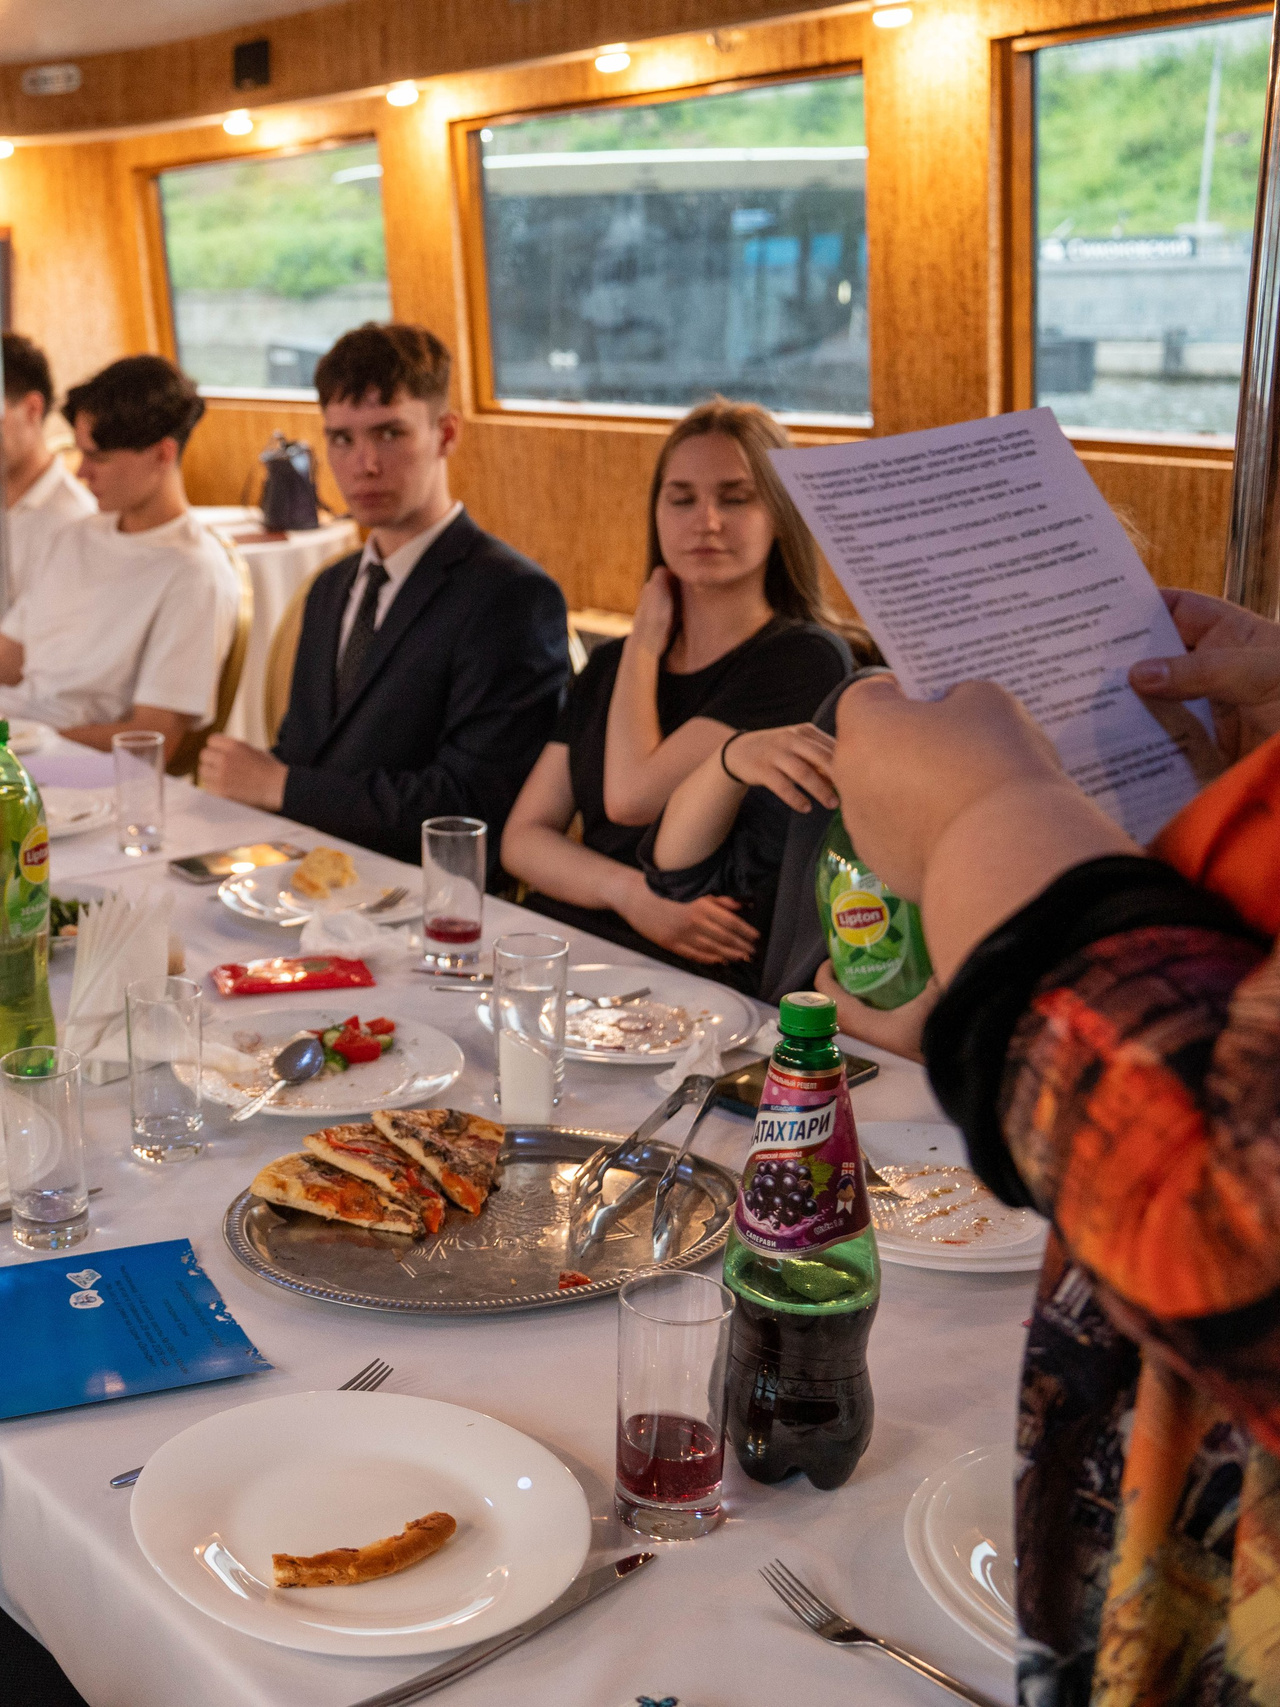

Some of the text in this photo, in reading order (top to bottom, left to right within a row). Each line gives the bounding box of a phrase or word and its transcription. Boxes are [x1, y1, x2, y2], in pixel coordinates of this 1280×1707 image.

[839, 910, 882, 926] Lipton
[751, 1111, 831, 1147] АТАХТАРИ
[745, 1229, 777, 1248] САПЕРАВИ
